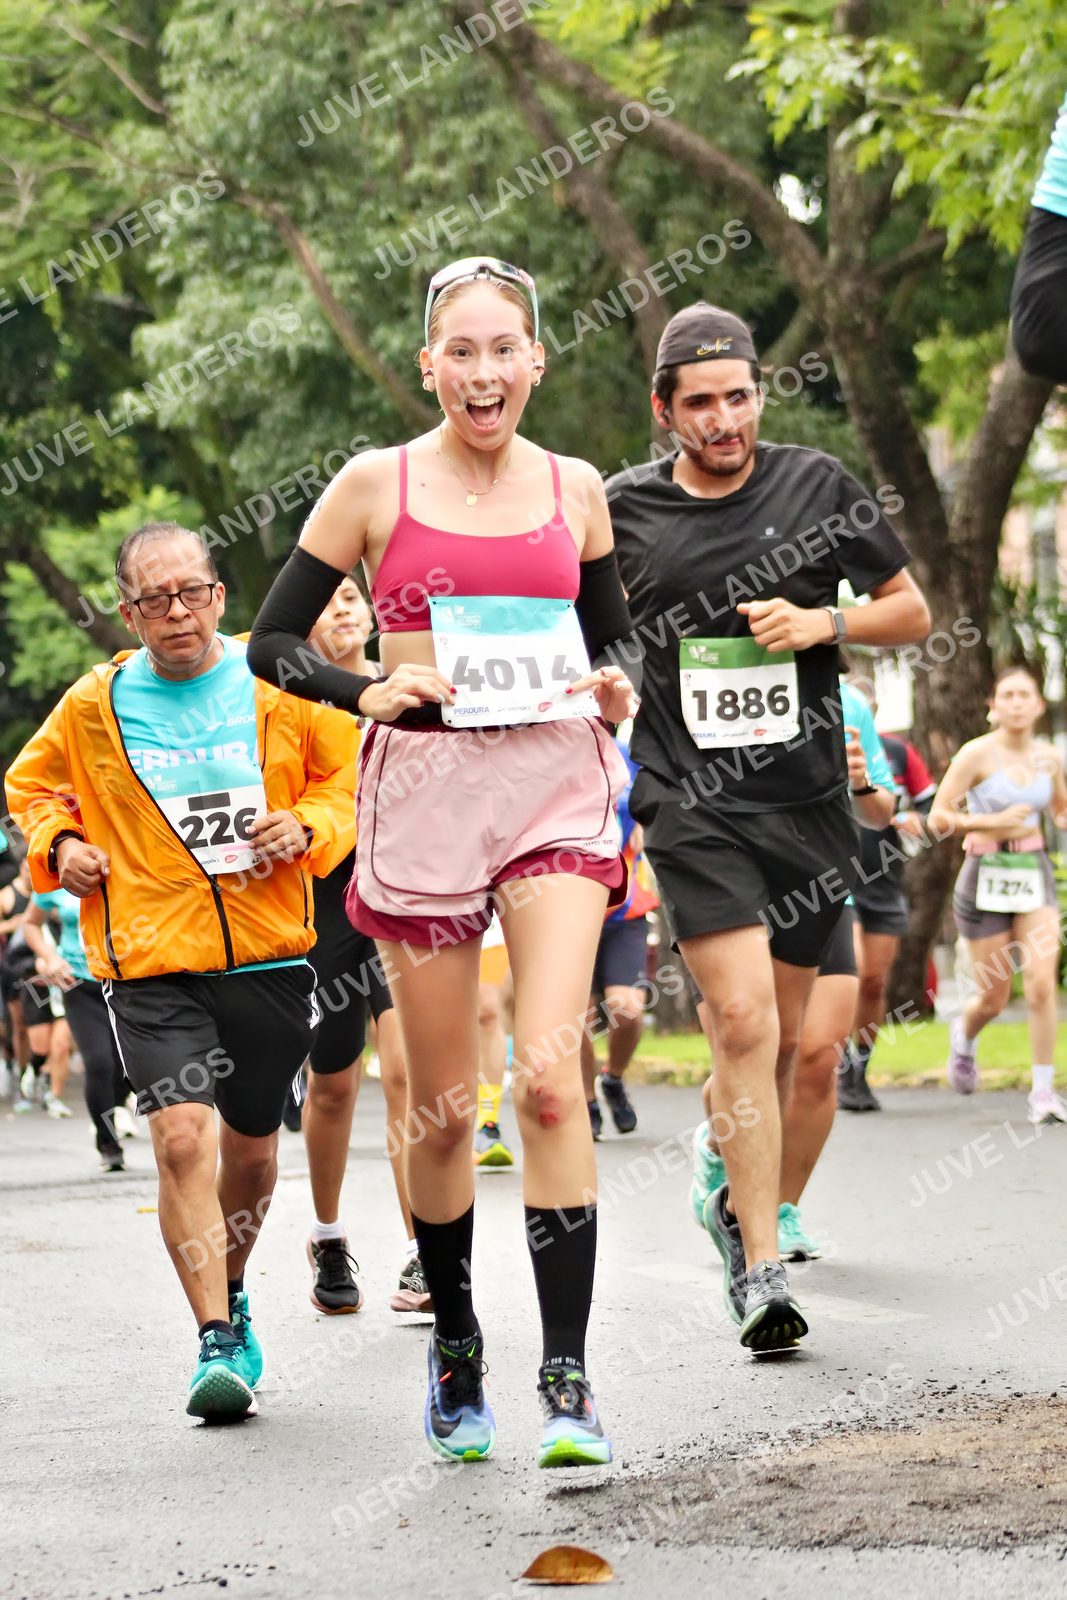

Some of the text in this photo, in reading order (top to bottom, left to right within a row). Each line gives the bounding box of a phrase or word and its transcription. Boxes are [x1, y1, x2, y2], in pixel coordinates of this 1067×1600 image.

[452, 655, 583, 692] 4014
[454, 706, 490, 715] PERDURA
[692, 684, 790, 721] 1886
[985, 878, 1034, 897] 1274
